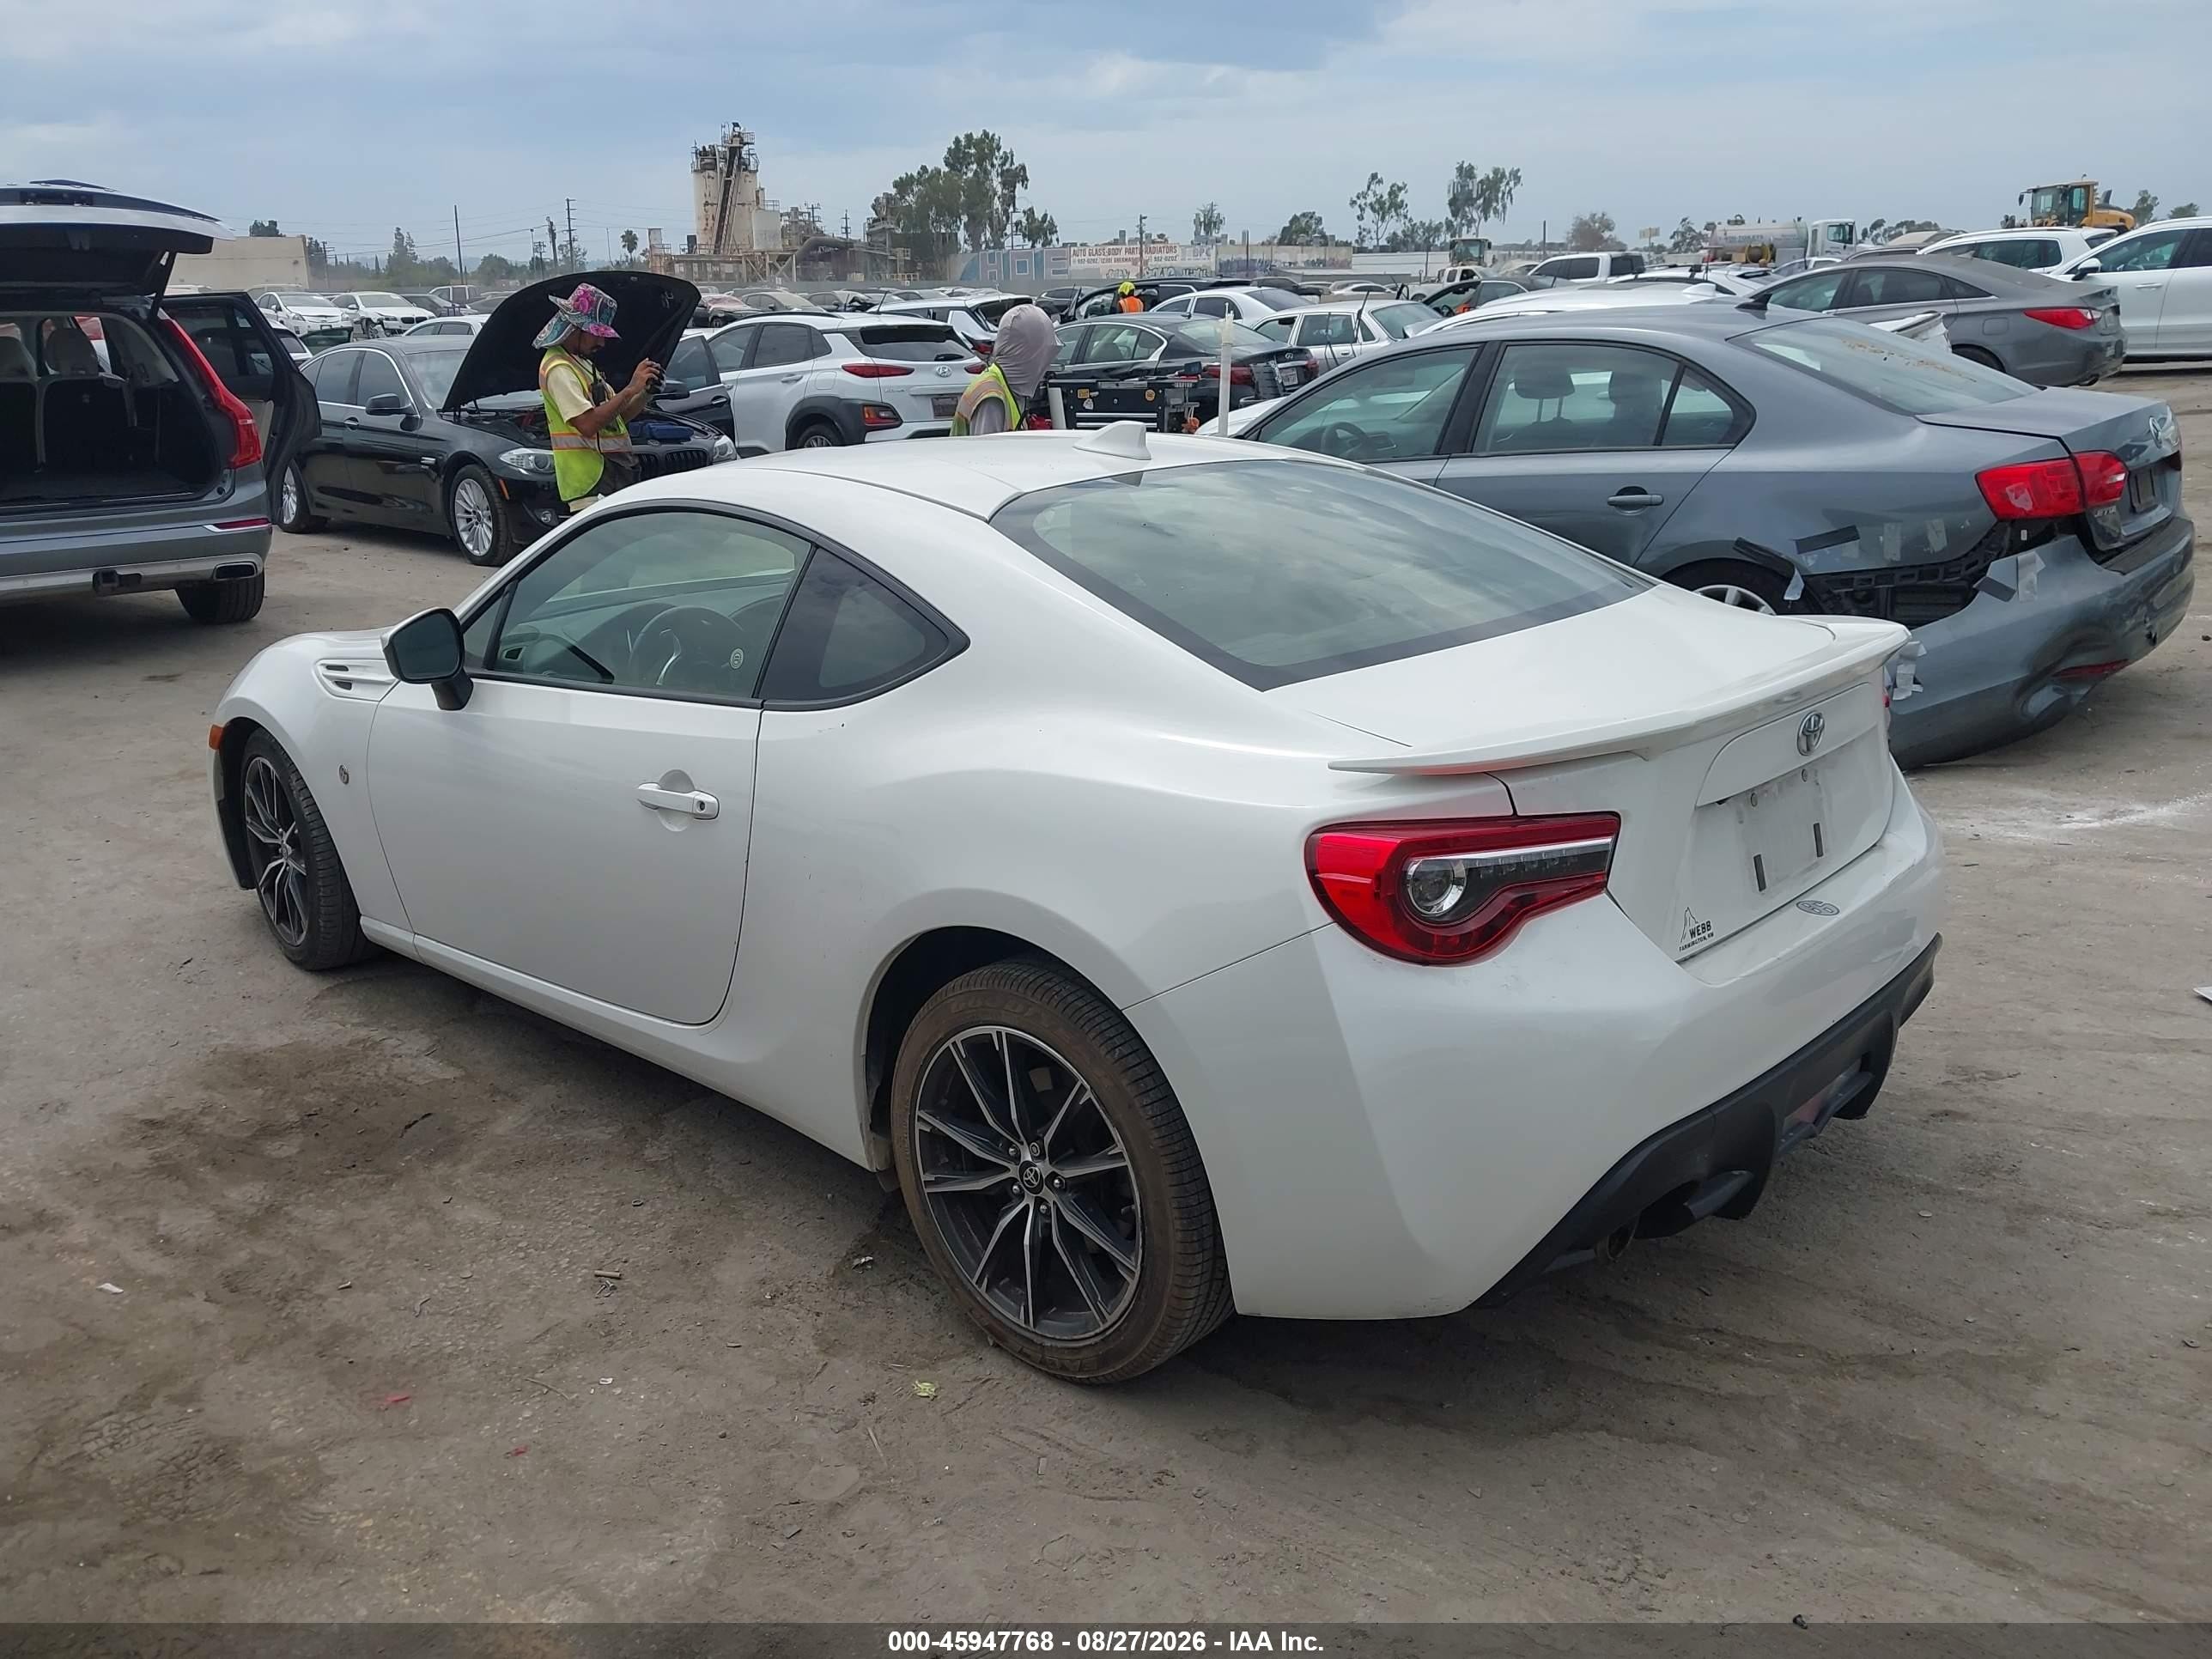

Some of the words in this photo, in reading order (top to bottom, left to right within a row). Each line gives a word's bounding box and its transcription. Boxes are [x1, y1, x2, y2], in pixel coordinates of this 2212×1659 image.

[1073, 247, 1086, 257] AUTO
[1124, 246, 1140, 255] PART
[1144, 246, 1177, 255] RADIATORS
[1688, 920, 1711, 939] WEBB
